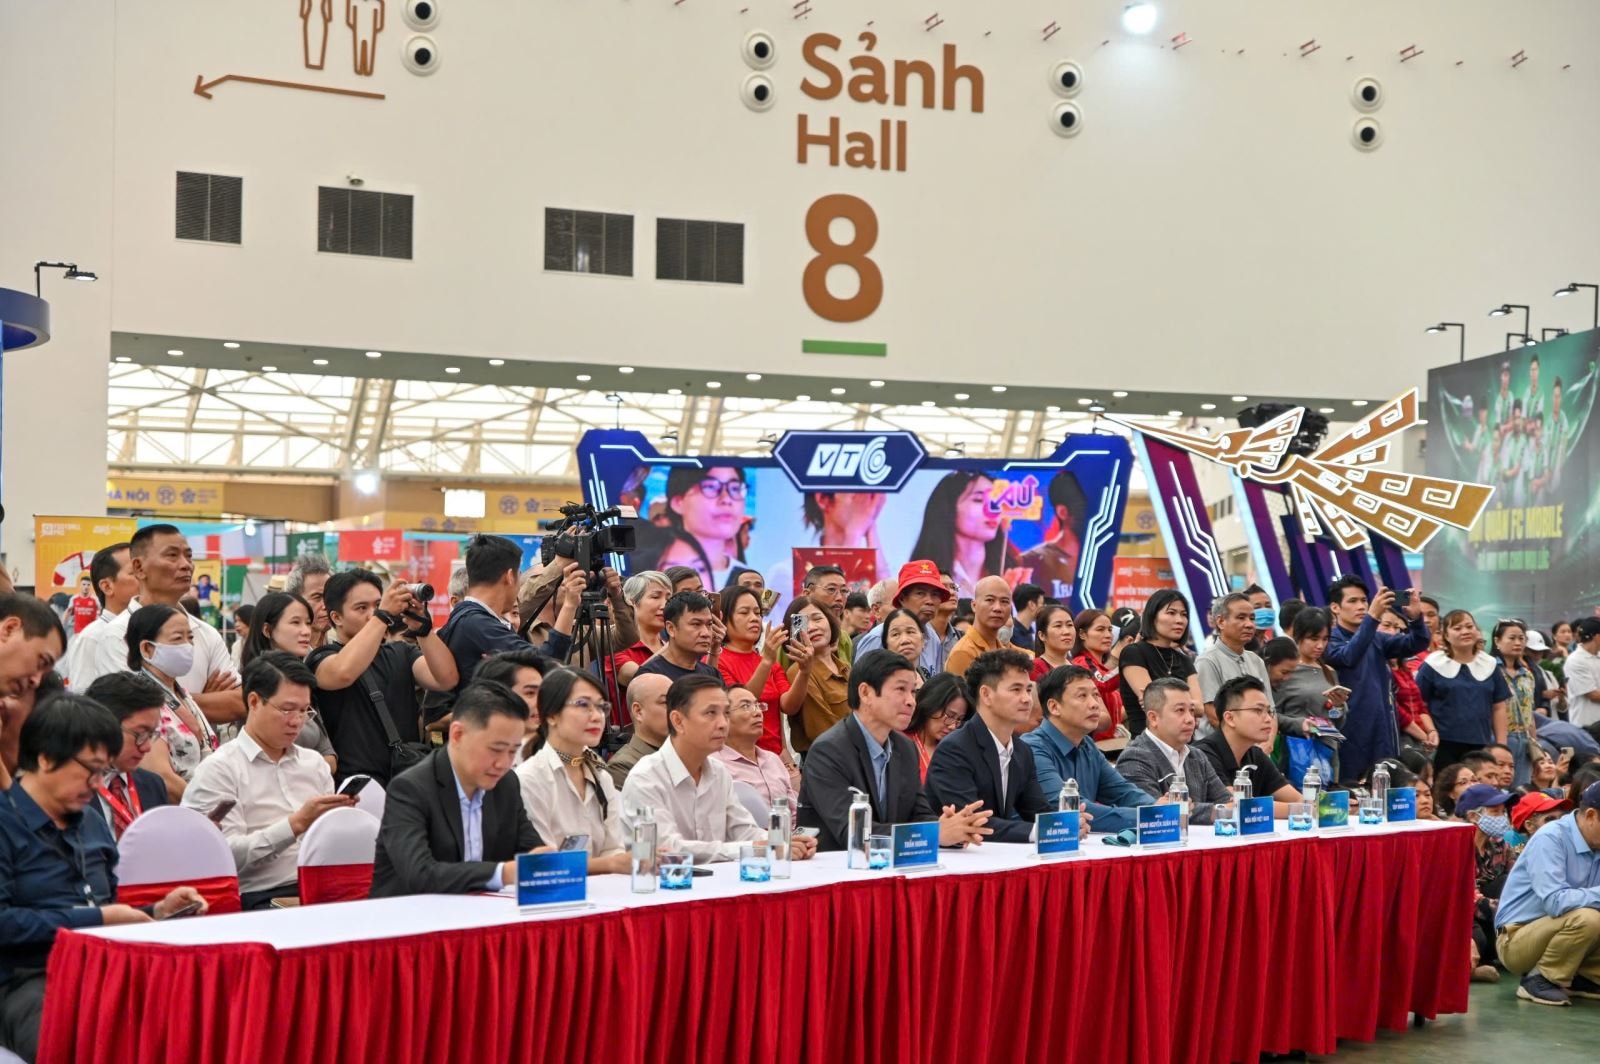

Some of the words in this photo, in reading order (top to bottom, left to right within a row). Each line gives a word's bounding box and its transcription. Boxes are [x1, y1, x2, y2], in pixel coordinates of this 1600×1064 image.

[799, 31, 985, 114] Sảnh
[797, 113, 907, 172] Hall
[802, 193, 884, 323] 8
[806, 436, 892, 485] VTC
[1525, 503, 1564, 538] MOBILE
